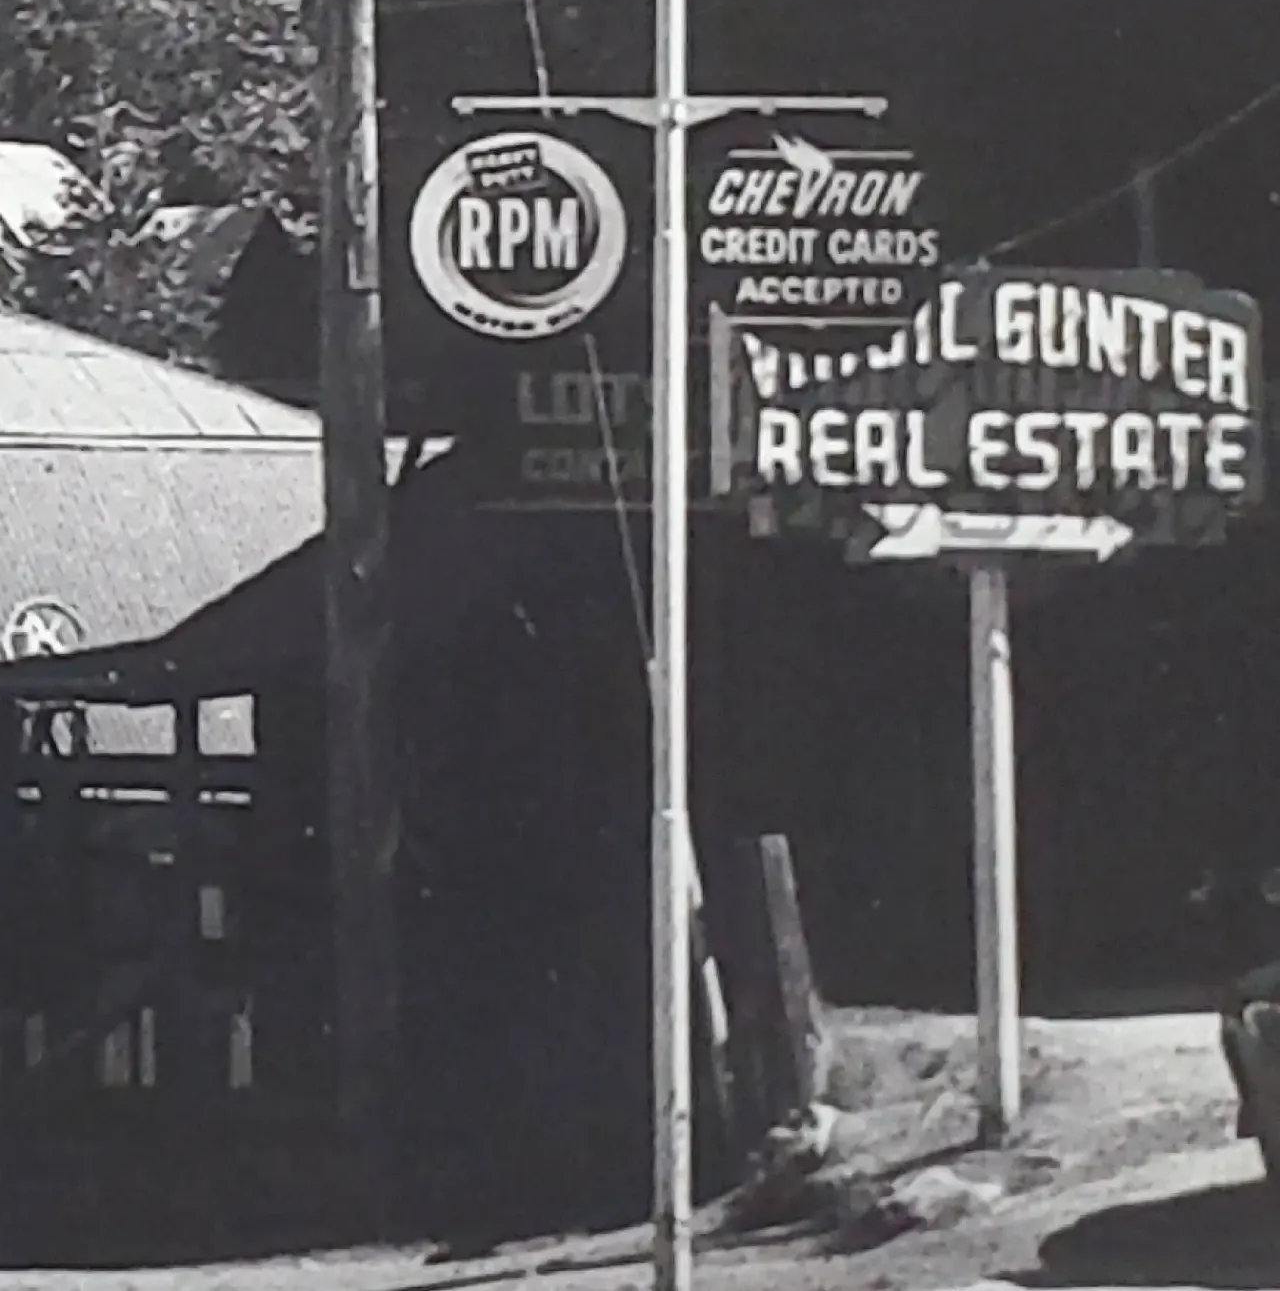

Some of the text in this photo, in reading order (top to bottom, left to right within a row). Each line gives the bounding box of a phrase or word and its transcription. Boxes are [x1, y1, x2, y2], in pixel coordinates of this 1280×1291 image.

[708, 166, 922, 218] CHEVRON
[457, 196, 578, 270] RPM
[700, 226, 939, 267] CREDIT CARDS
[736, 276, 903, 304] ACCEPTED
[995, 283, 1247, 410] GUNTER
[756, 408, 1246, 492] REAL ESTATE
